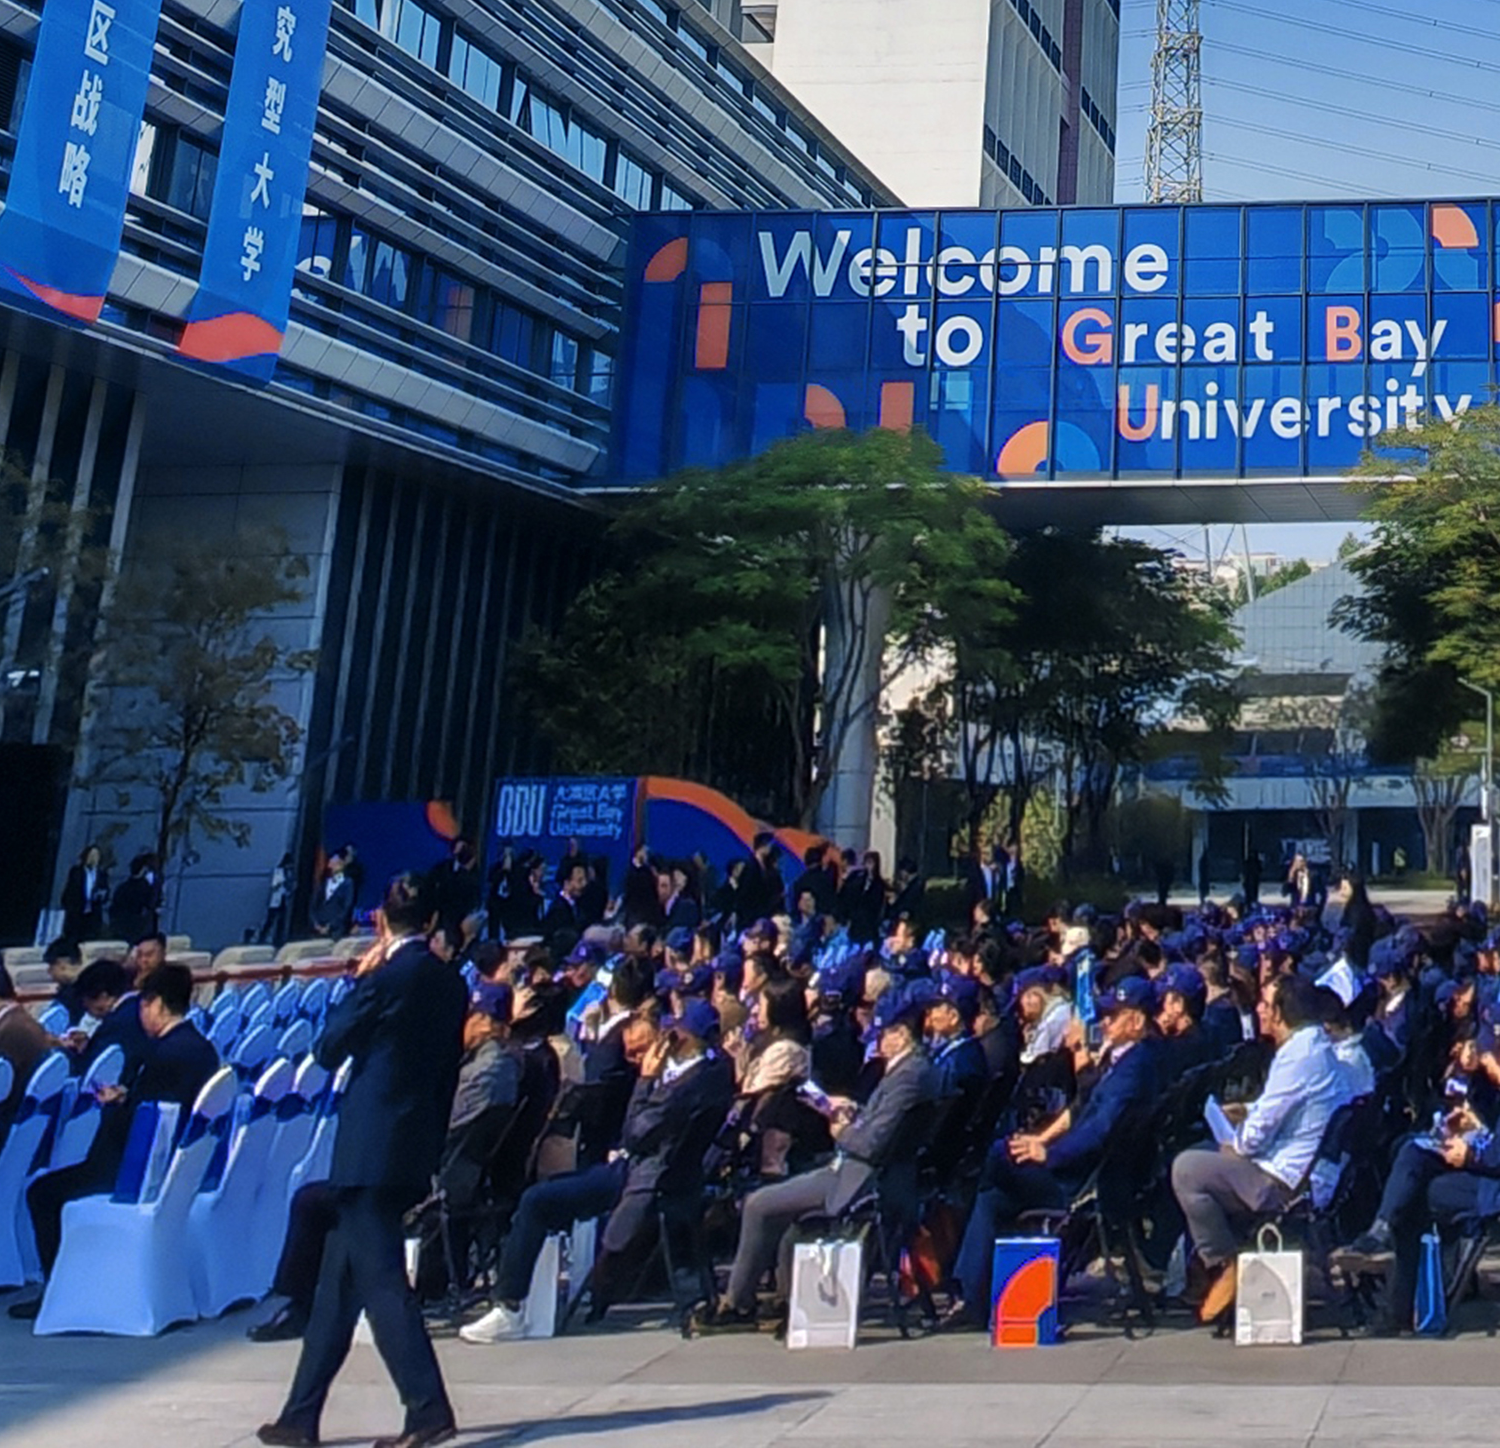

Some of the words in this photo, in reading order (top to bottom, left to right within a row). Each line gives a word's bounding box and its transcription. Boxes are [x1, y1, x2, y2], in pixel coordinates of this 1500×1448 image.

[758, 227, 1169, 298] Welcome
[896, 303, 984, 368] to
[1061, 307, 1275, 366] Great
[1324, 305, 1449, 378] Bay
[1117, 377, 1472, 441] University
